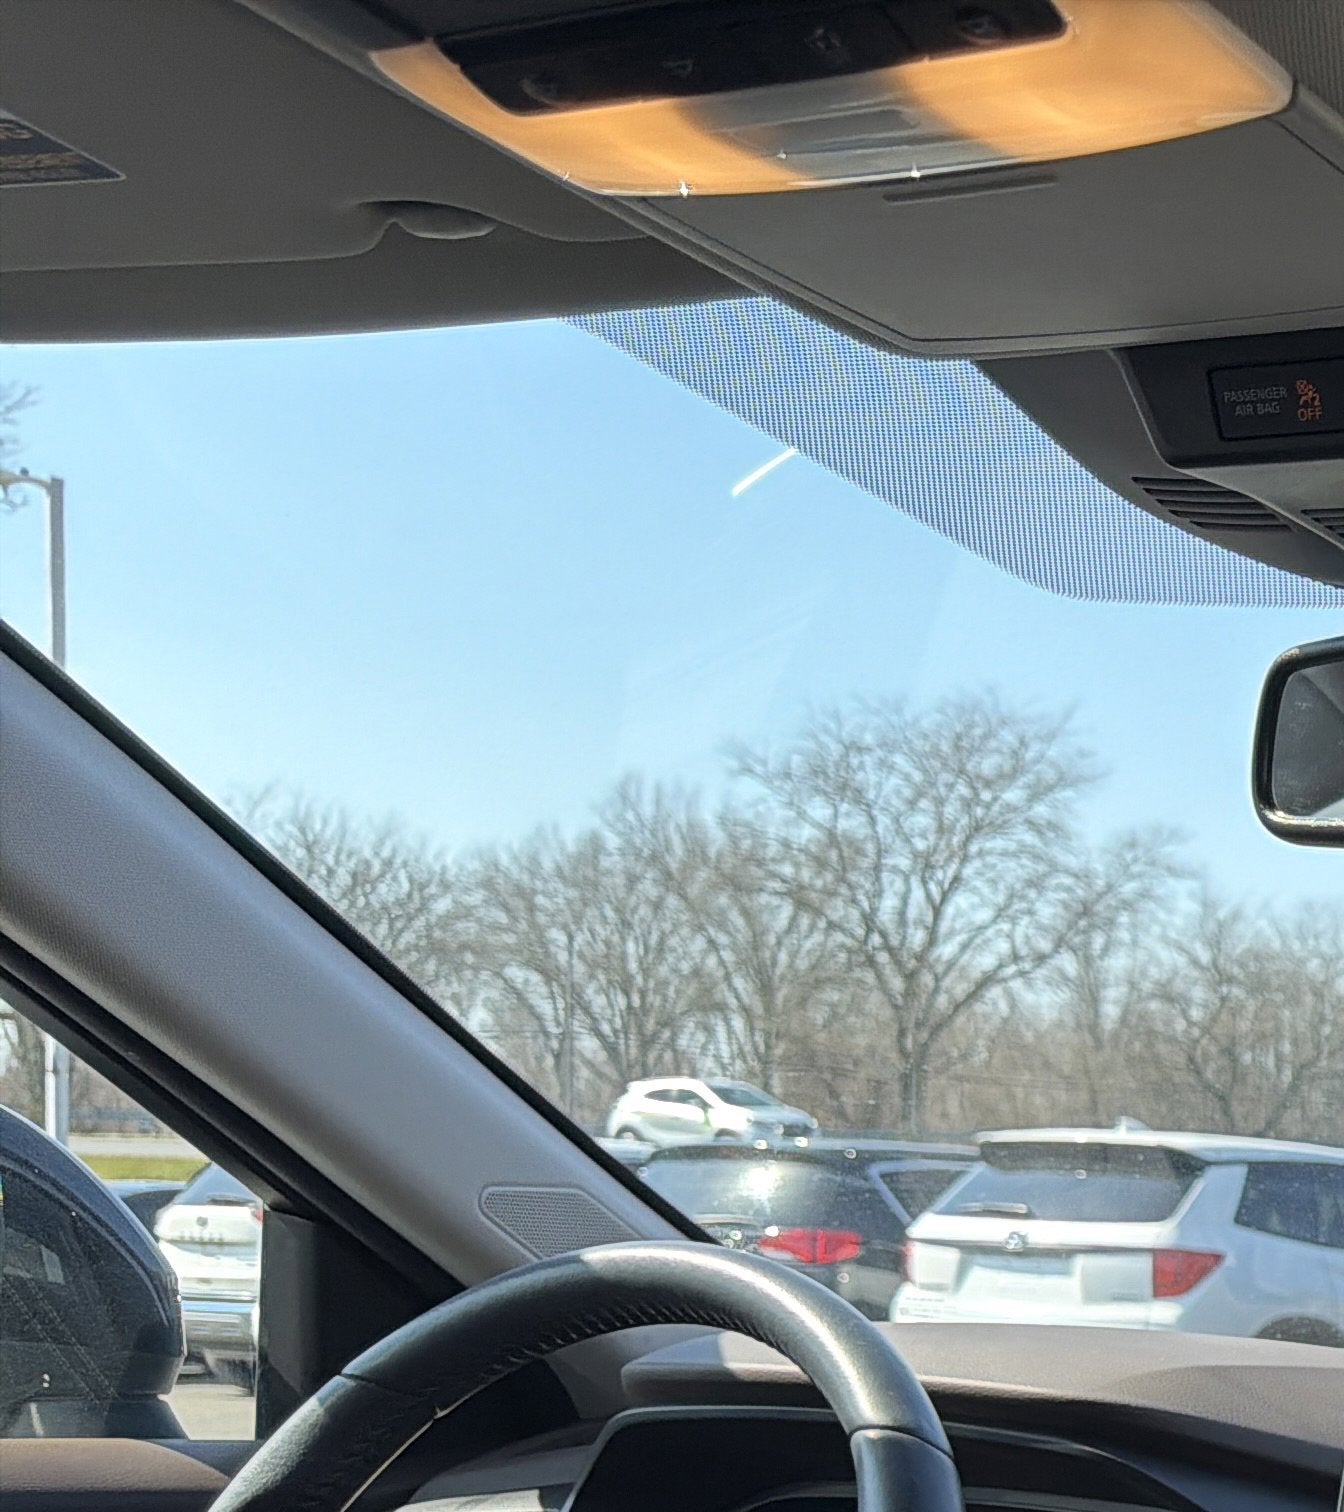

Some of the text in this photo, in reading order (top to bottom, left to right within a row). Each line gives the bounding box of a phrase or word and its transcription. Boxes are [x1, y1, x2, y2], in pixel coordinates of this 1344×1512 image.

[1223, 386, 1288, 403] PASSENGER
[1234, 401, 1281, 417] AIR BAG
[1297, 407, 1323, 422] OFF
